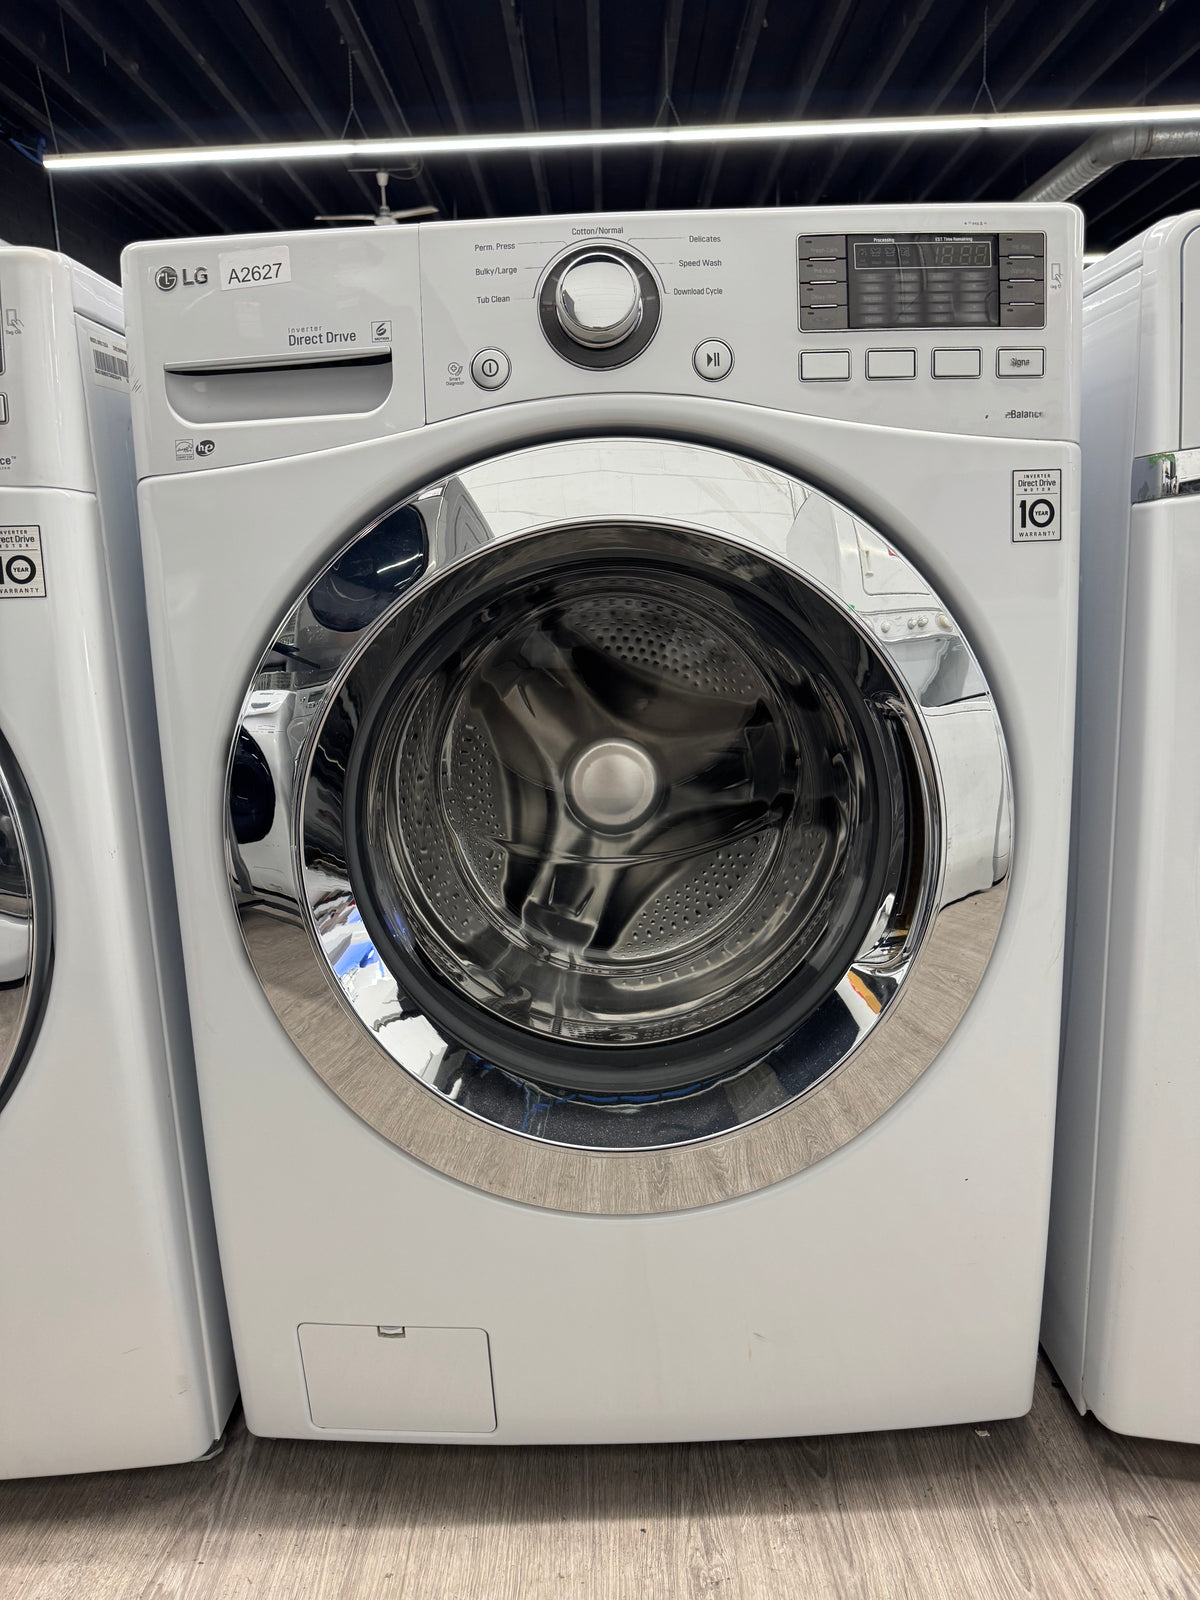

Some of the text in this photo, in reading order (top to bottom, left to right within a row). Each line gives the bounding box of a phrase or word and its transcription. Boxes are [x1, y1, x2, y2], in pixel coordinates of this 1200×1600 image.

[571, 226, 624, 236] Cotton/Normal
[688, 235, 722, 243] Delicates
[474, 242, 516, 252] Perm. Press
[678, 259, 723, 268] Speed Wash
[182, 266, 209, 286] LG
[228, 262, 283, 285] A2627
[475, 267, 518, 276] Bulky/Large
[673, 287, 723, 296] Download Cycle
[476, 295, 511, 304] Tub Clean
[288, 331, 357, 346] Direct Drive
[1018, 479, 1038, 487] Direct
[1019, 498, 1055, 528] 10
[15, 535, 35, 543] Drive
